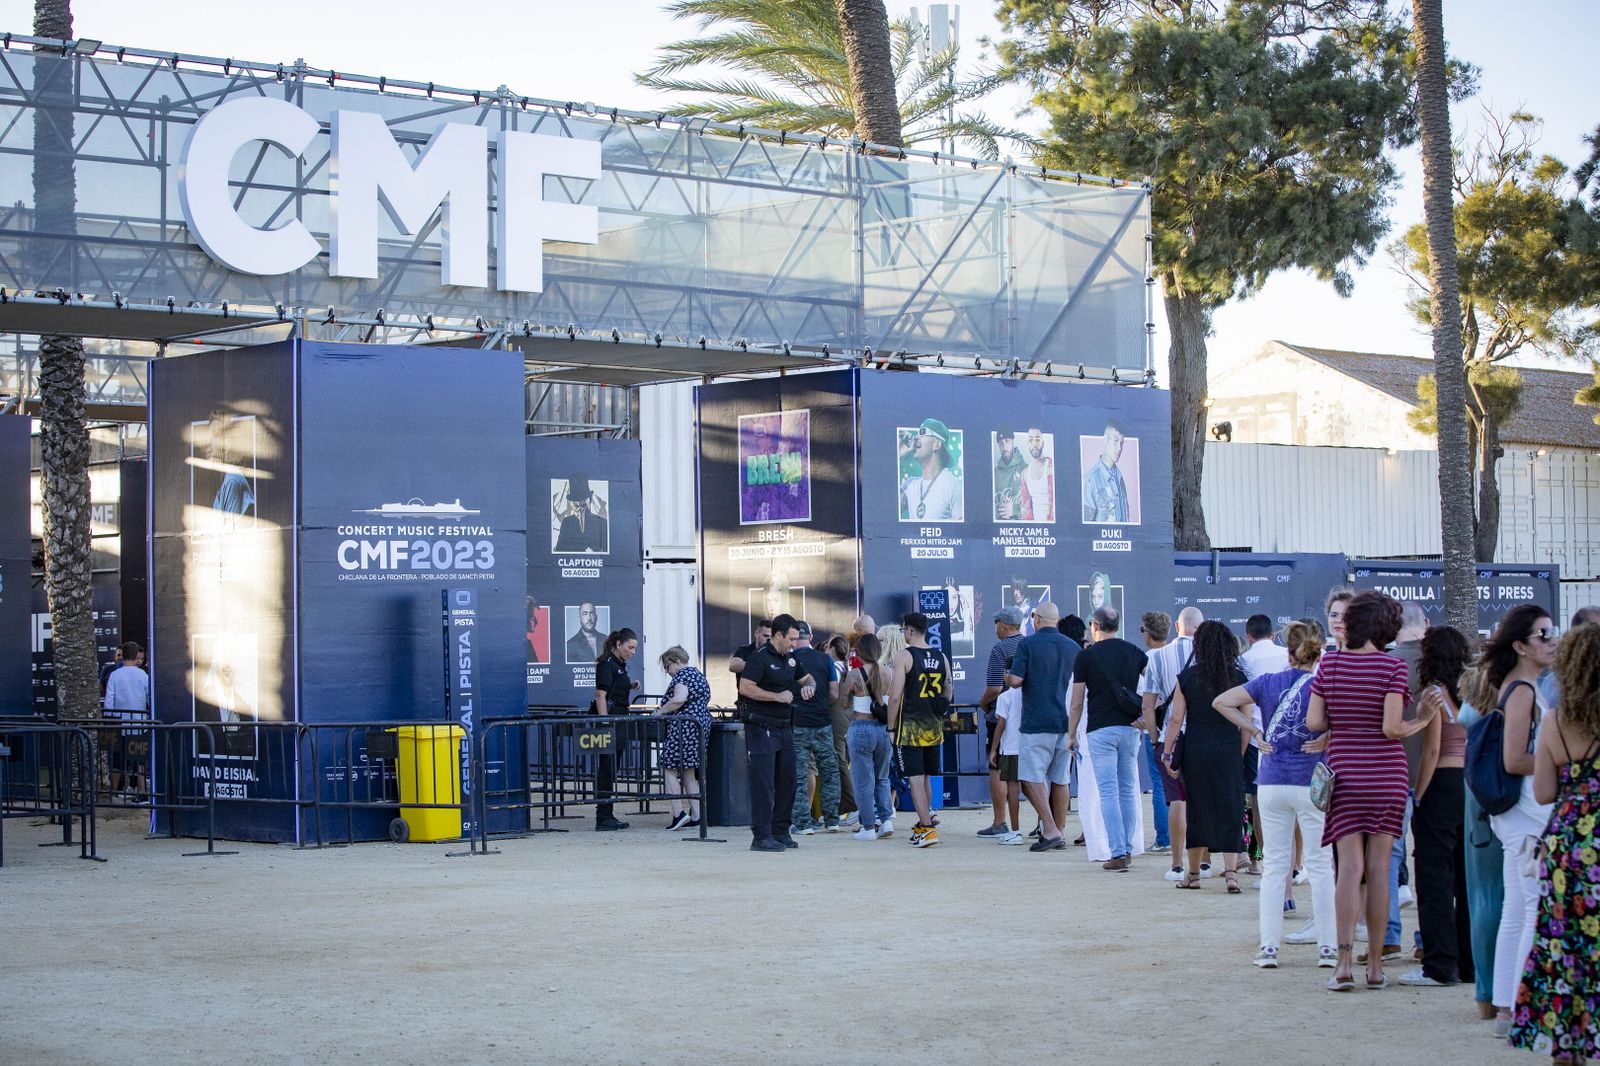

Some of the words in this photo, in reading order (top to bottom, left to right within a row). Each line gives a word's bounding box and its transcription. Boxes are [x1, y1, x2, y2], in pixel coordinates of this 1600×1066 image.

[179, 96, 602, 293] CMF
[91, 505, 114, 522] MF
[337, 525, 394, 536] CONCERT
[397, 525, 435, 536] MUSIC
[438, 526, 494, 536] FESTIVAL
[758, 529, 794, 541] BRESH
[920, 527, 942, 537] FEID
[999, 527, 1024, 536] NICKY
[1024, 527, 1042, 536] JAM
[1043, 527, 1050, 536] &
[1101, 528, 1122, 539] DUKI
[900, 538, 926, 546] FERXXO
[927, 538, 947, 546] NITRO
[947, 538, 962, 546] JAM
[992, 536, 1027, 546] MANUEL
[1027, 536, 1056, 546] TURIZO
[1103, 542, 1129, 550] AGOSTO
[337, 539, 495, 570] CMF2023
[730, 548, 740, 558] 30
[741, 547, 766, 557] JUNIO
[770, 546, 776, 555] 2
[777, 546, 783, 555] Y
[783, 546, 791, 555] 15
[792, 545, 824, 554] AGOSTO
[917, 549, 926, 557] 20
[926, 549, 948, 557] JULIO
[1010, 548, 1019, 556] 07
[1019, 548, 1040, 556] JULIO
[558, 558, 603, 567] CLAPTONE
[573, 569, 598, 577] AGOSTO
[1276, 574, 1291, 583] CMF
[1374, 585, 1436, 601] TAQUILLA
[1498, 585, 1534, 600] PRESS
[1245, 595, 1260, 604] CMF
[454, 618, 474, 626] PISTA
[459, 630, 471, 689] PISTA
[918, 673, 942, 698] 23
[579, 733, 611, 749] CMF
[192, 765, 222, 780] DAVD
[223, 766, 260, 782] BISBA
